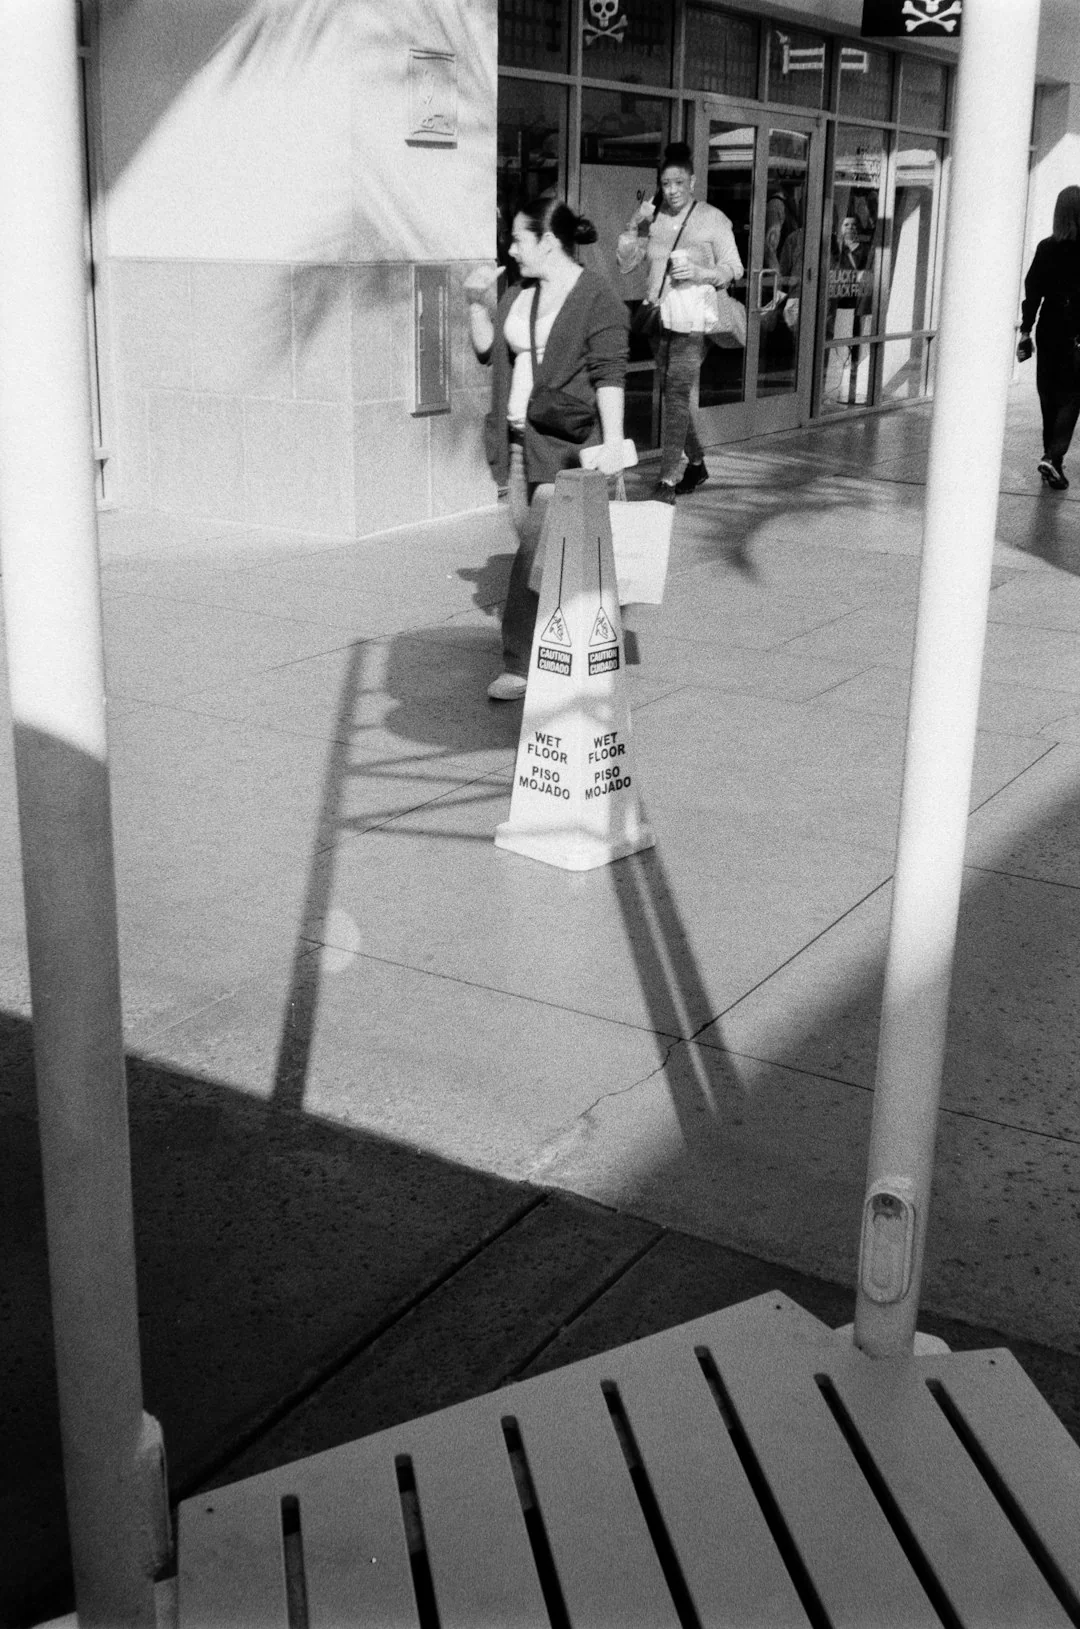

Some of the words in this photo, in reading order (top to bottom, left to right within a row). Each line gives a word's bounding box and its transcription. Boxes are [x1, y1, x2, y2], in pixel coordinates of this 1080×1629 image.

[540, 647, 571, 664] CAUTION
[589, 648, 618, 663] CAUTION
[539, 659, 570, 675] CUIDADO
[589, 659, 618, 674] CUIDADO
[535, 731, 562, 748] WET
[594, 732, 618, 748] WET
[527, 743, 568, 764] FLOOR
[588, 743, 626, 764] FLOOR
[532, 765, 560, 783] PISO
[594, 765, 620, 783] PISO
[519, 775, 570, 800] MOJADO
[585, 776, 631, 800] MOJADO
